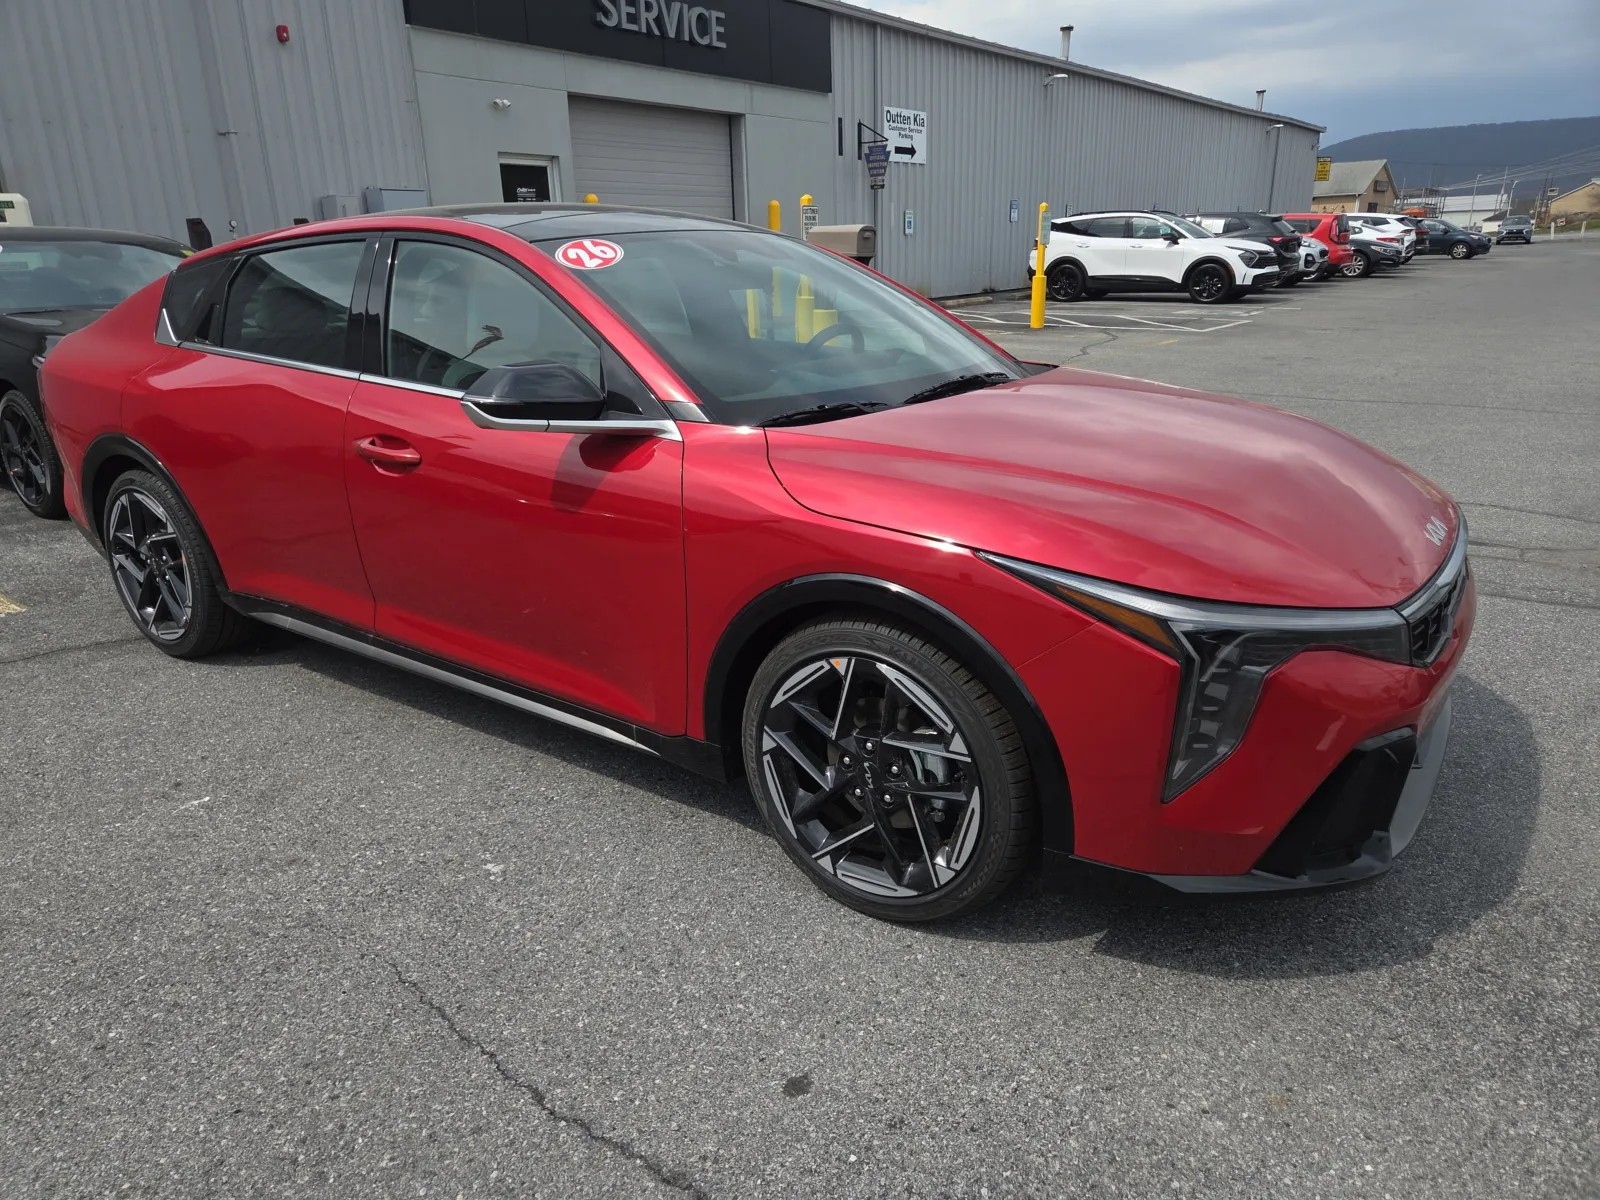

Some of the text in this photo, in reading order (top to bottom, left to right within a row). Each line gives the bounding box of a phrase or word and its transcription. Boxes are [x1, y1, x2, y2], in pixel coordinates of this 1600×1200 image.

[596, 0, 727, 48] SERVICE
[886, 110, 925, 127] Outten Kia
[888, 124, 907, 132] Customer
[898, 132, 913, 141] Parking
[566, 239, 616, 268] 26
